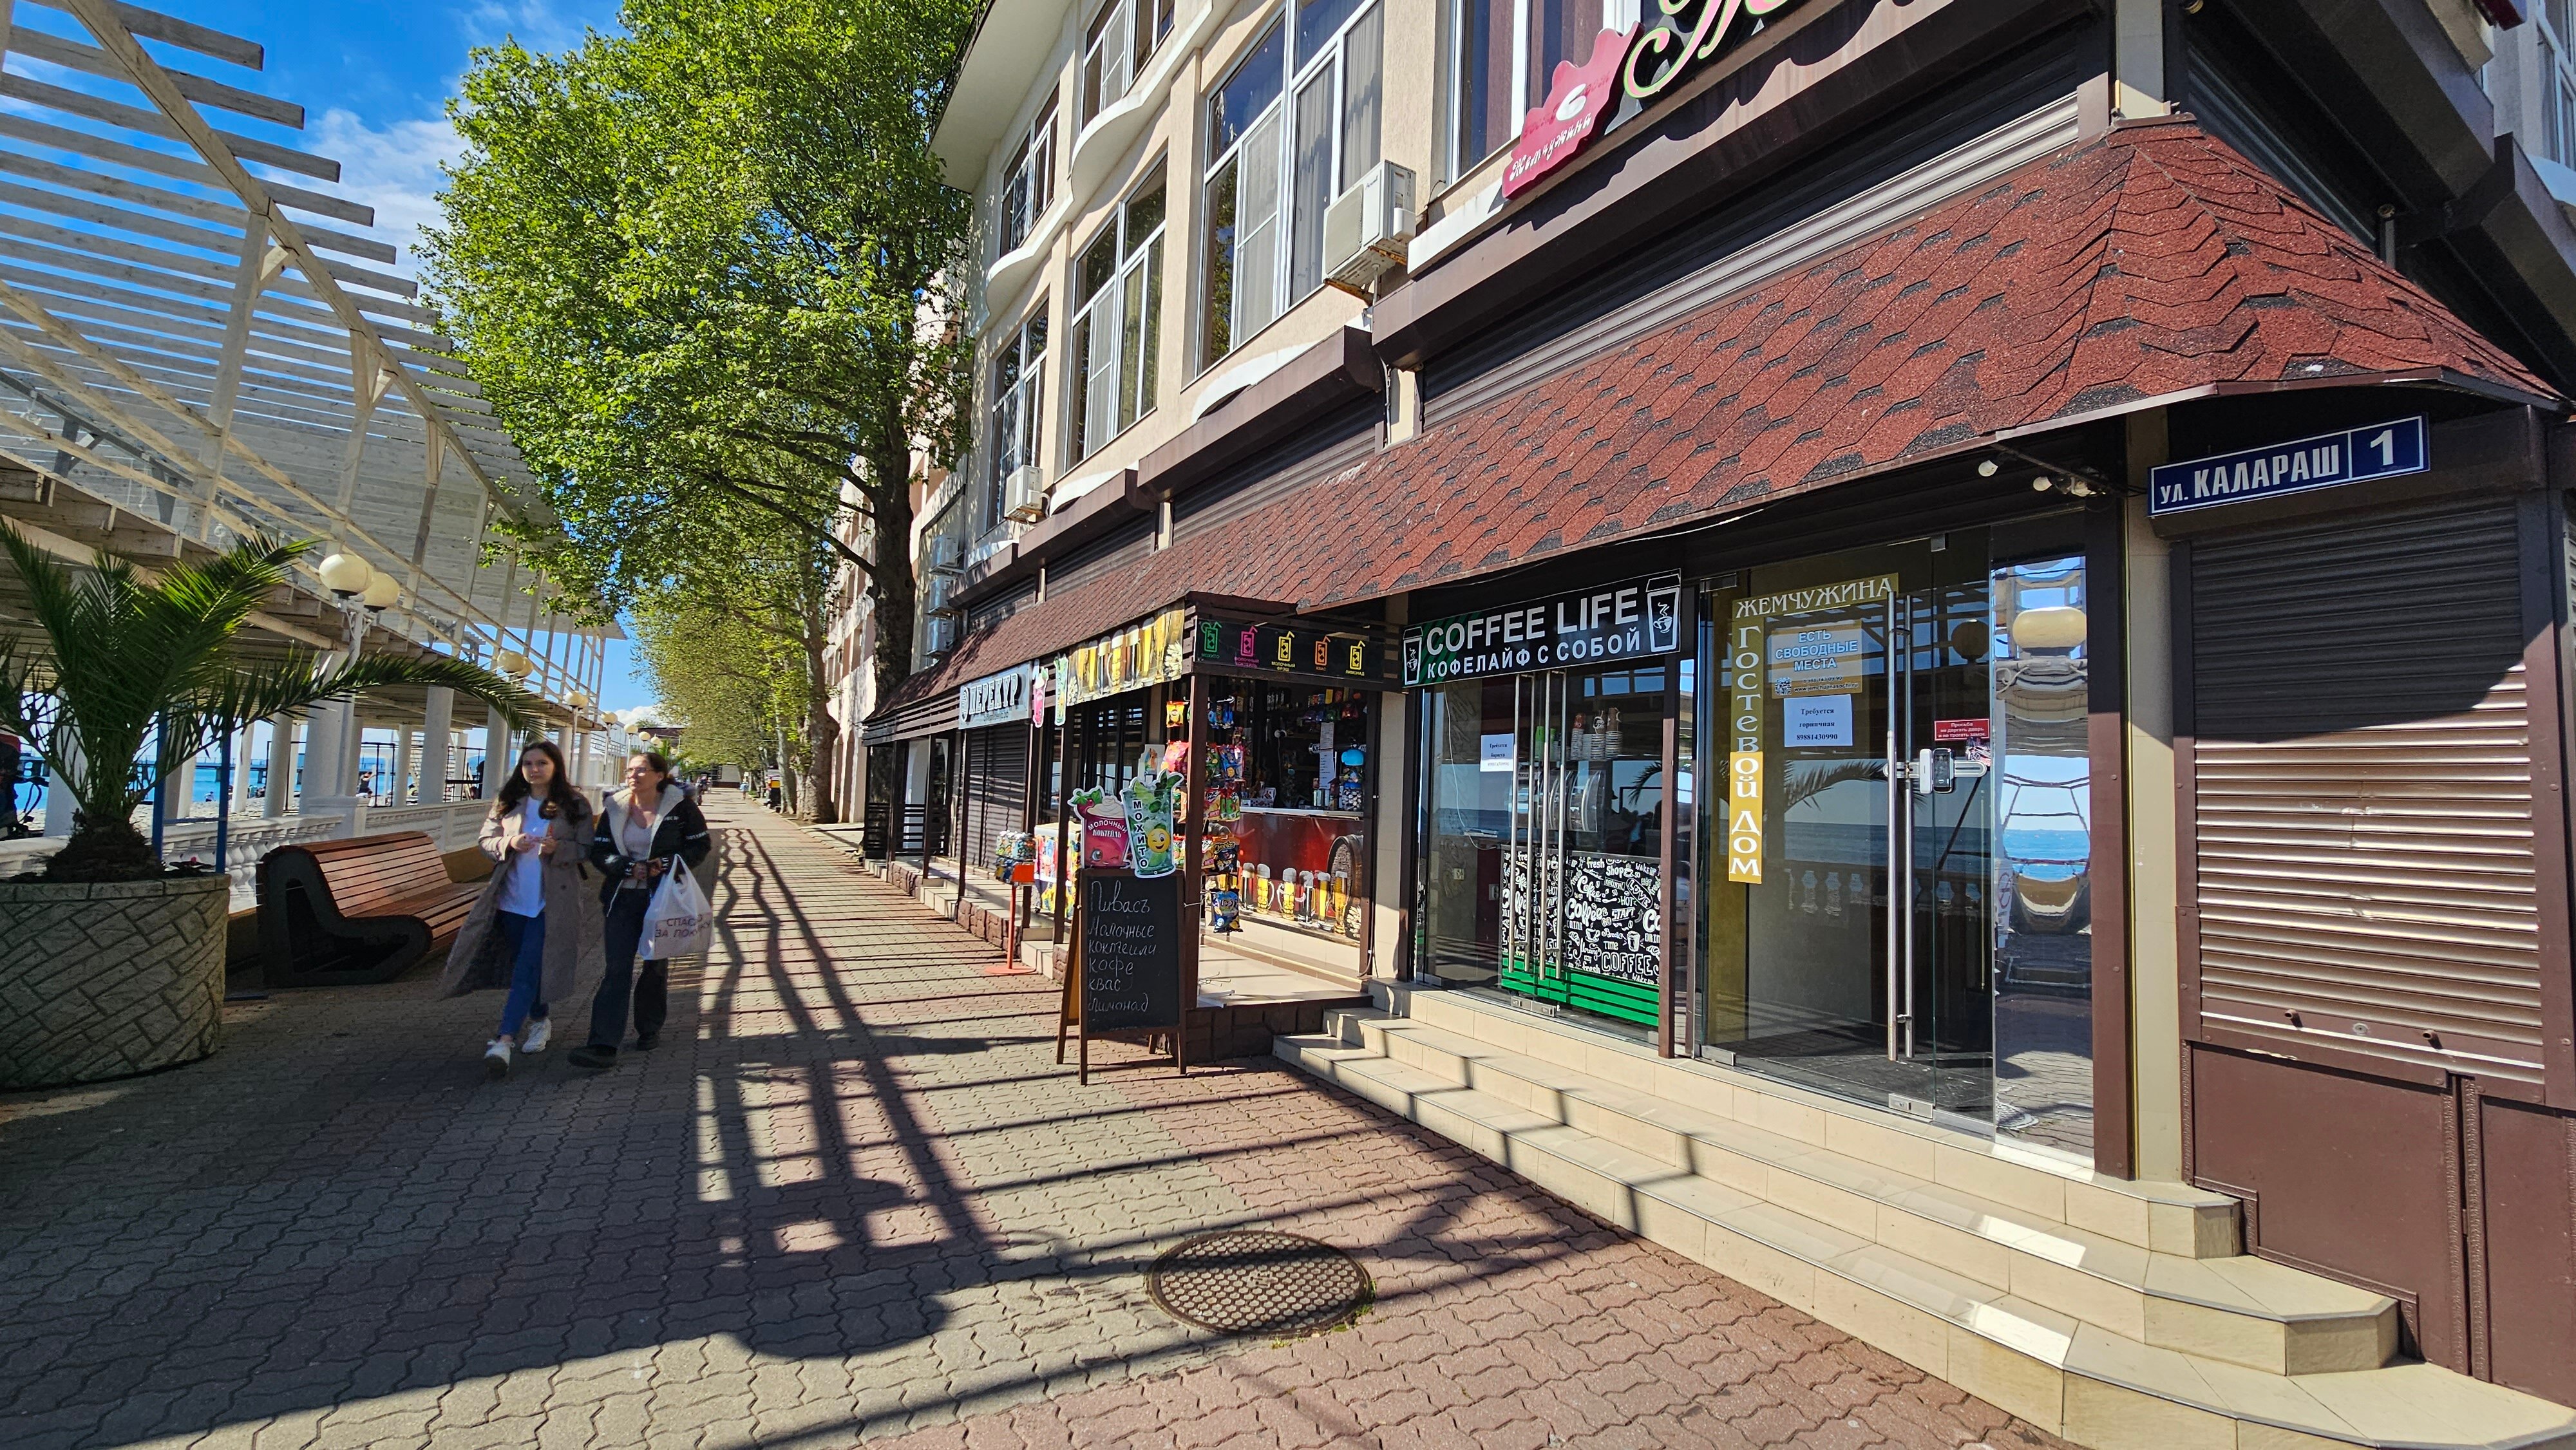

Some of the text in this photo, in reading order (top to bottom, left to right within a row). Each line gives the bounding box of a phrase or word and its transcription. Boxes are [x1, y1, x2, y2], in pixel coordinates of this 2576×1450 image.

[1509, 112, 1592, 182] Жемчужина
[2160, 429, 2394, 505] ул. КАЛАРАШ 1
[1736, 577, 1893, 619] ЖЕМЧУЖИНА
[1426, 587, 1638, 656] COFFEE LIFE
[1776, 641, 1858, 659] СВОБОДНЫЕ
[1799, 630, 1832, 643] ЕСТЬ
[1427, 626, 1640, 679] КОФЕЛАЙФ С СОБОЙ
[1794, 657, 1837, 672] МЕСТА
[969, 673, 1019, 715] ПЕРЕКУР
[1092, 829, 1122, 838] КОКТЕЙЛЬ
[1133, 801, 1148, 867] МОХИТО
[1586, 856, 1605, 869] fresh
[1090, 880, 1150, 913] Пивасъ
[1577, 875, 1602, 901] Coffee
[1620, 895, 1635, 907] HOT
[1627, 879, 1651, 908] LOVE
[667, 914, 703, 927] СПАСО
[1564, 898, 1603, 927] Coffee
[1601, 951, 1654, 976] COFFEE
